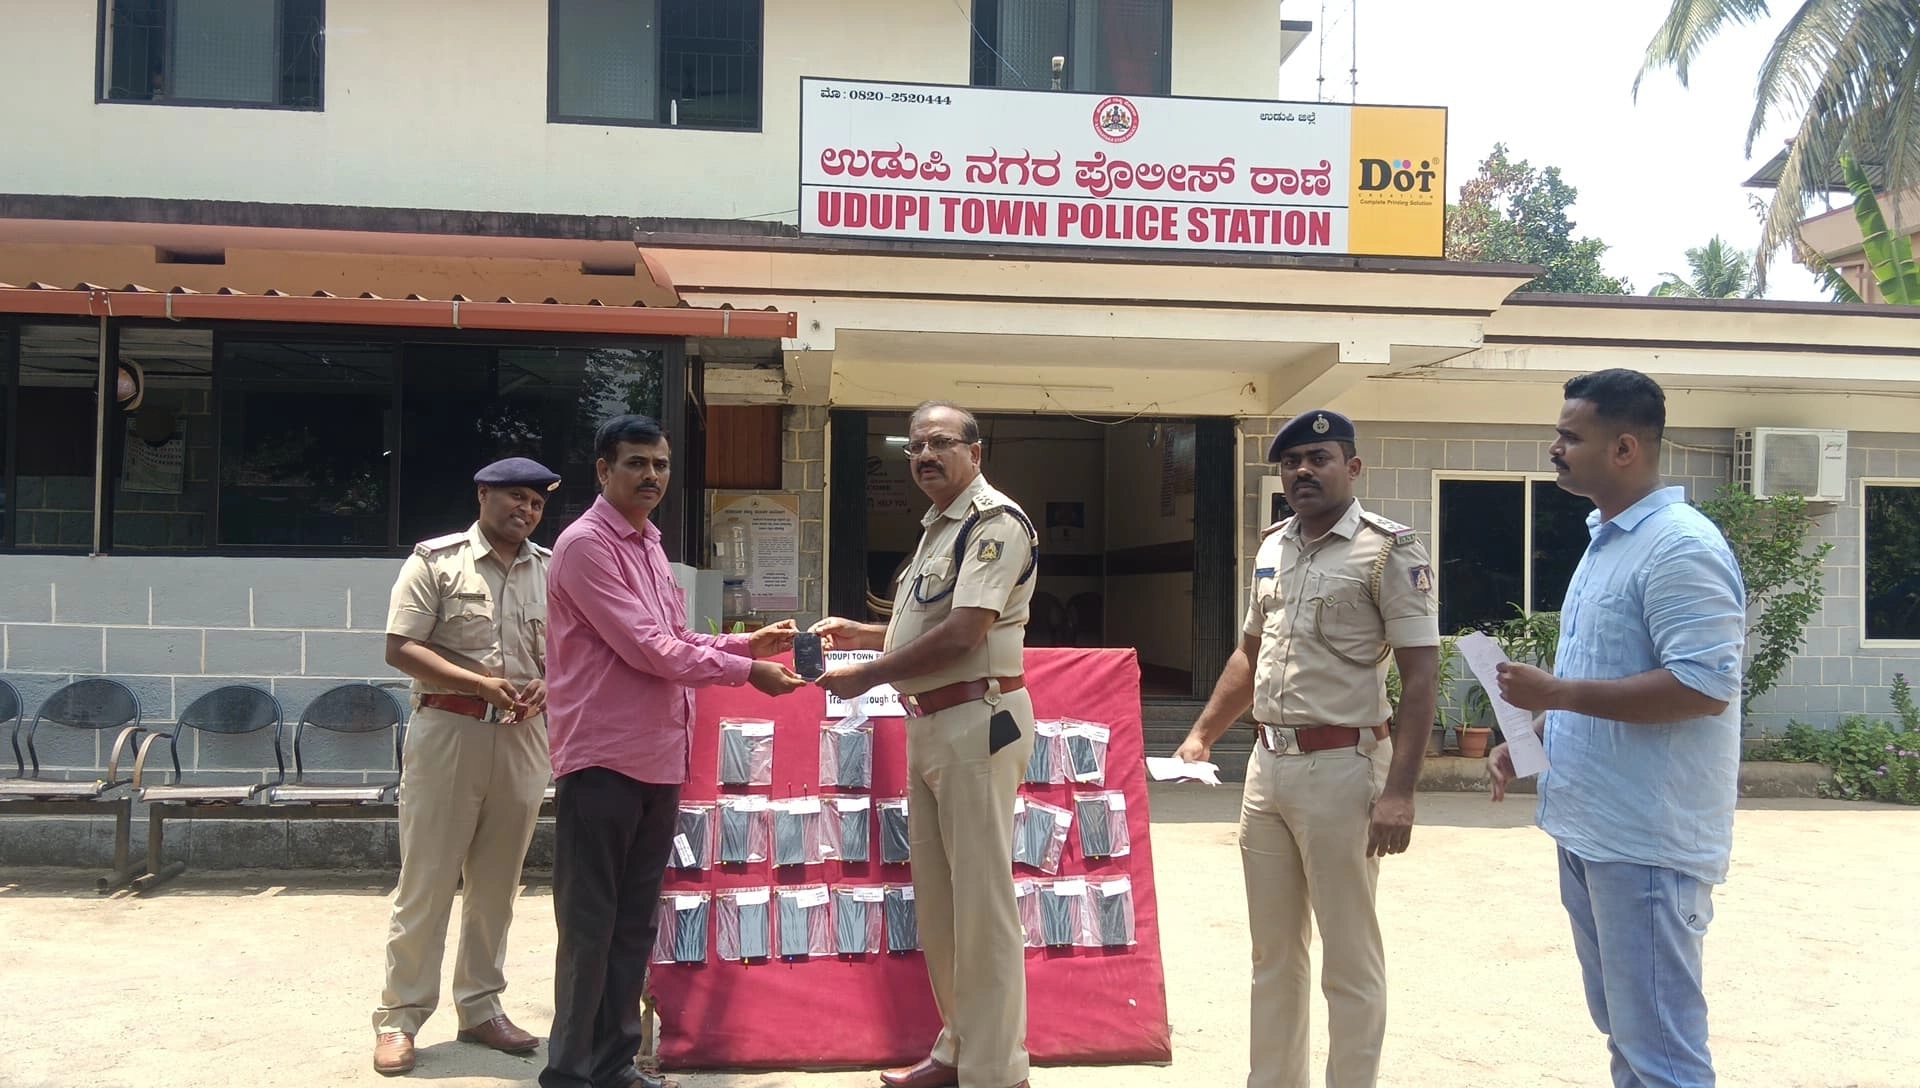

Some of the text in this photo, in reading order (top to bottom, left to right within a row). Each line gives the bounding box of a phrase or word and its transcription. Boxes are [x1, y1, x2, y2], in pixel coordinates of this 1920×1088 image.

[849, 90, 952, 105] 0820-2520444
[820, 141, 1332, 198] ಉಡುಪಿ ನಗರ ಪೊಲೀಸ್ ಠಾಣೆ
[818, 191, 1331, 247] UDUPI TOWN POLICE STATION
[827, 653, 850, 661] UDUPI
